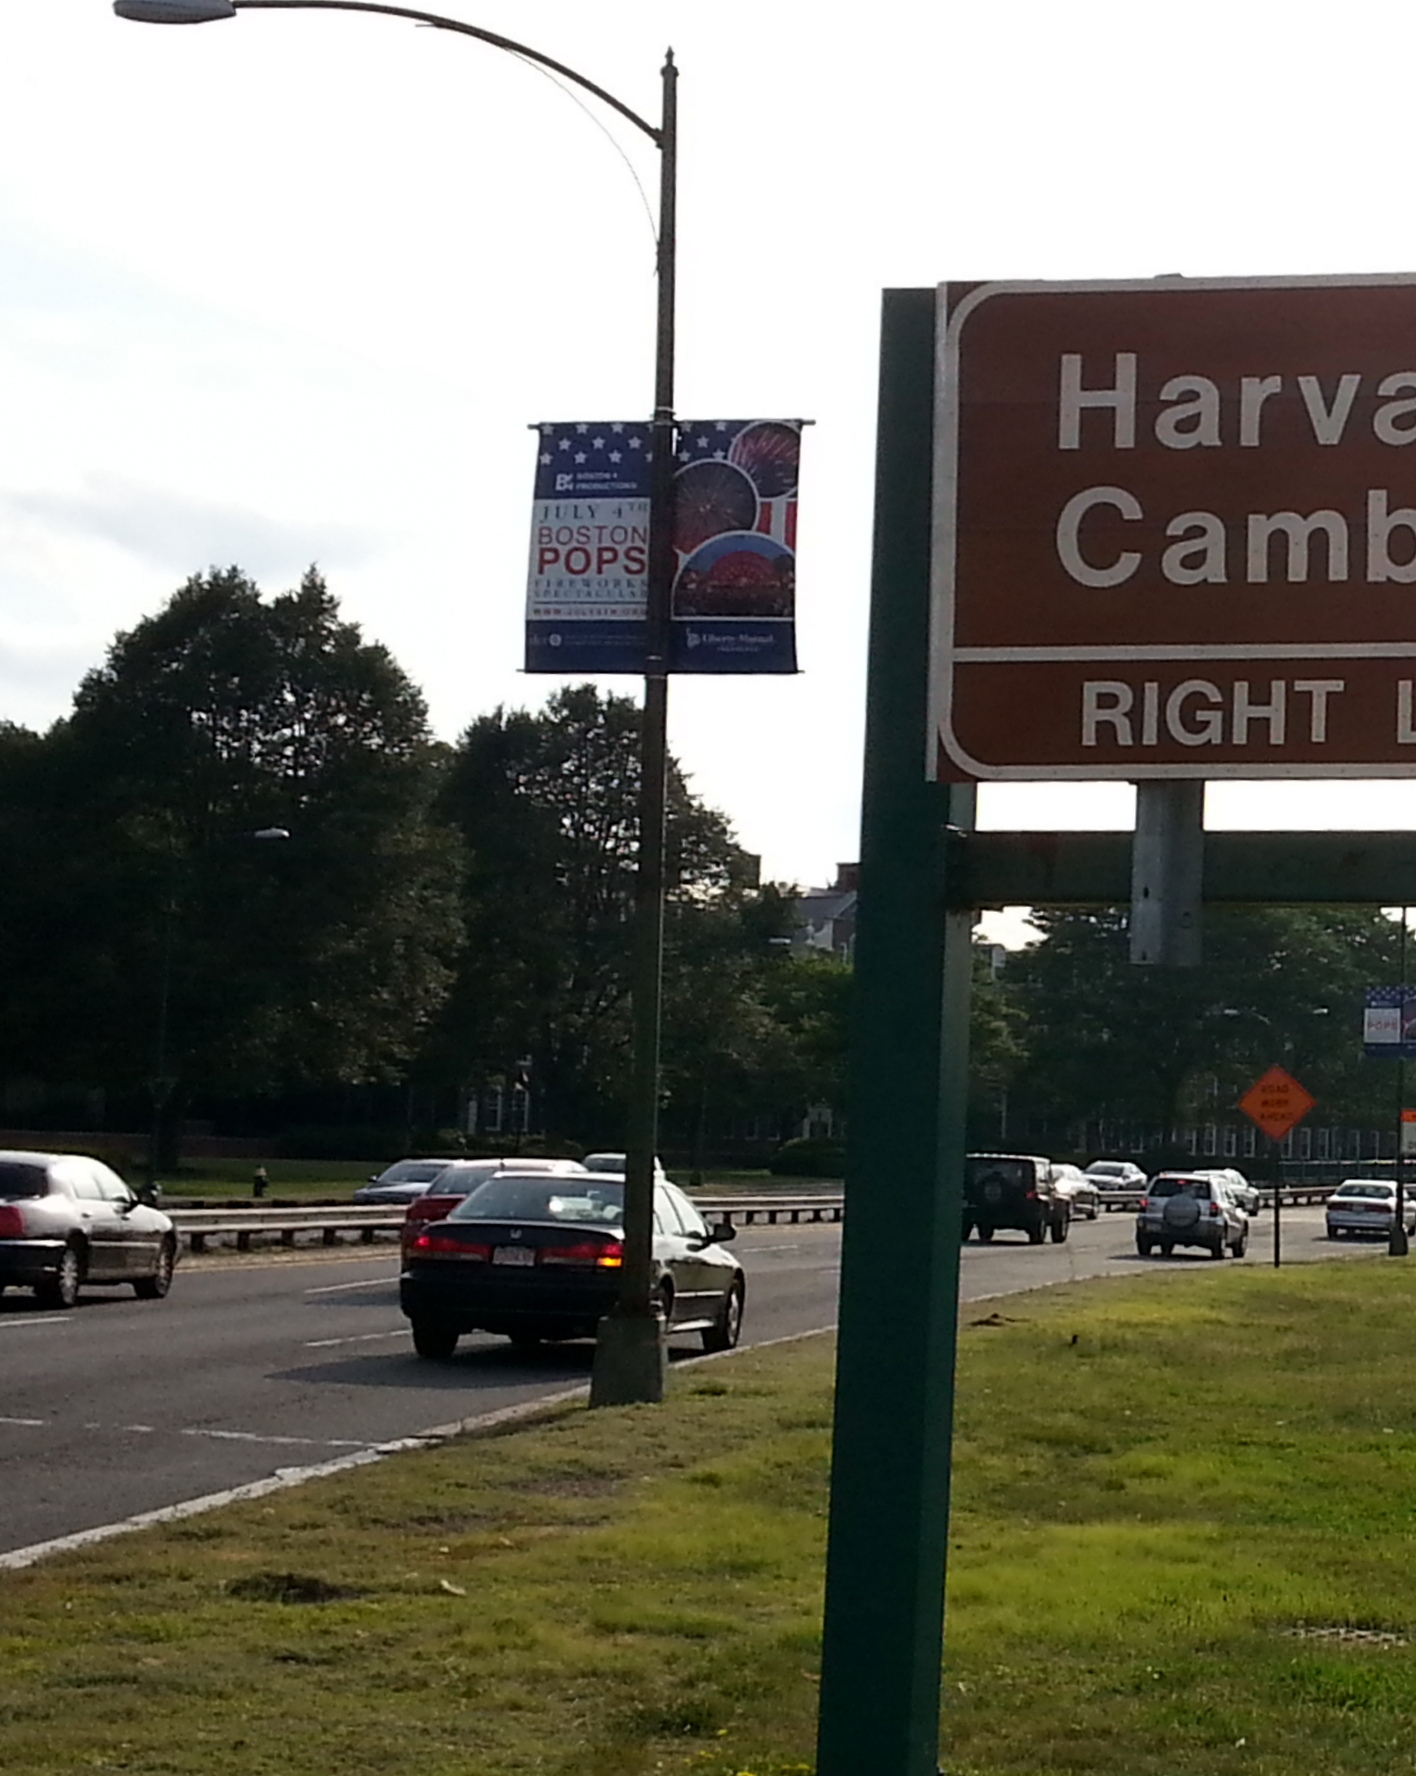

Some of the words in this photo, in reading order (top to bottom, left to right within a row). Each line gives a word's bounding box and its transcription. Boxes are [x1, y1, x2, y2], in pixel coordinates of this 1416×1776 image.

[538, 504, 598, 524] JULY
[538, 525, 648, 546] BOSTON
[536, 545, 647, 576] POPS
[1080, 680, 1345, 749] RIGHT
